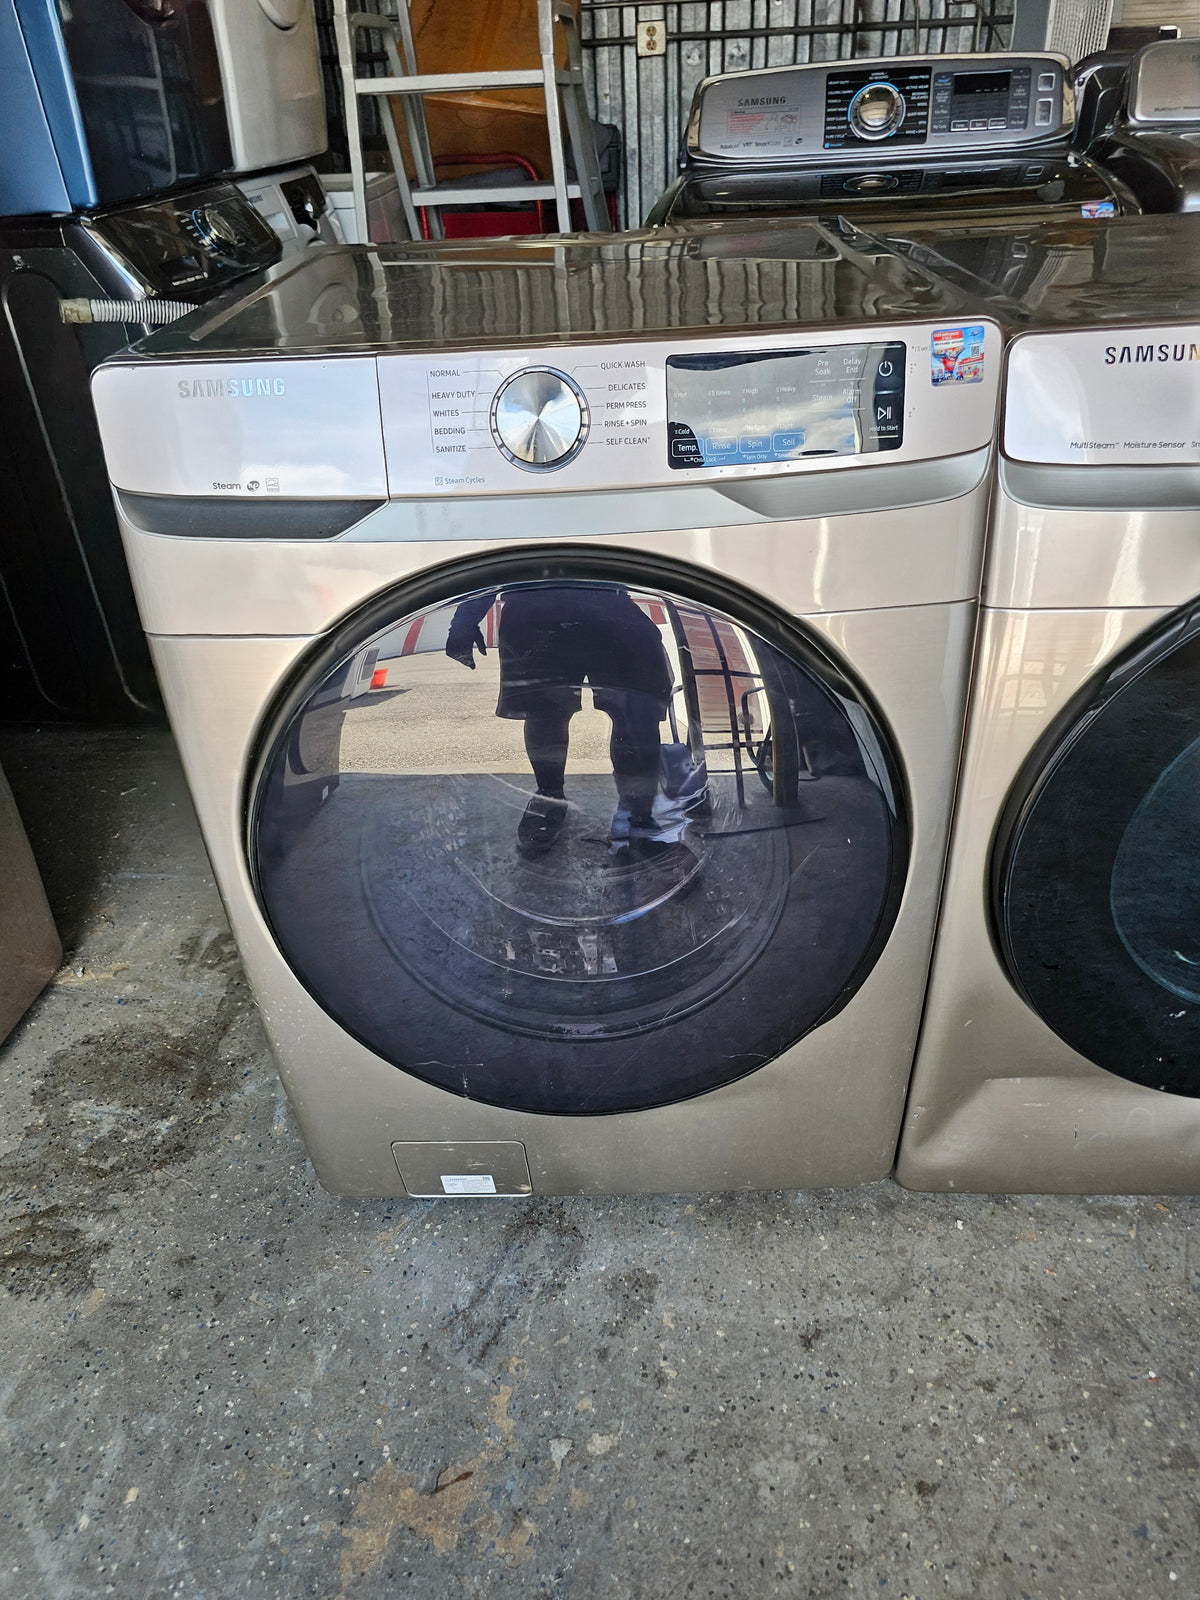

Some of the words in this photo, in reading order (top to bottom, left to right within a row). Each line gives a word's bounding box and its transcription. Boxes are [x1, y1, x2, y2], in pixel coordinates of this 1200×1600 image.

[737, 96, 786, 107] SAMSUNG
[600, 362, 623, 370] QUICK
[624, 360, 646, 368] WASH
[843, 358, 861, 366] Delay
[430, 369, 460, 377] NORMAL
[178, 377, 286, 399] SAMSUNG
[608, 383, 646, 391] DELICATES
[432, 391, 455, 399] HEAVY
[457, 390, 475, 399] DUTY
[433, 409, 459, 417] WHITES
[630, 419, 647, 427] SPIN
[434, 427, 465, 435] BEDDING
[747, 440, 762, 448] Spin
[782, 438, 795, 446] Soil
[1123, 441, 1157, 449] Moisture
[1157, 441, 1186, 449] Sensor
[435, 445, 466, 453] SANITIZE
[677, 444, 698, 453] Temp.
[465, 476, 485, 485] Cycles
[212, 482, 241, 490] Steam
